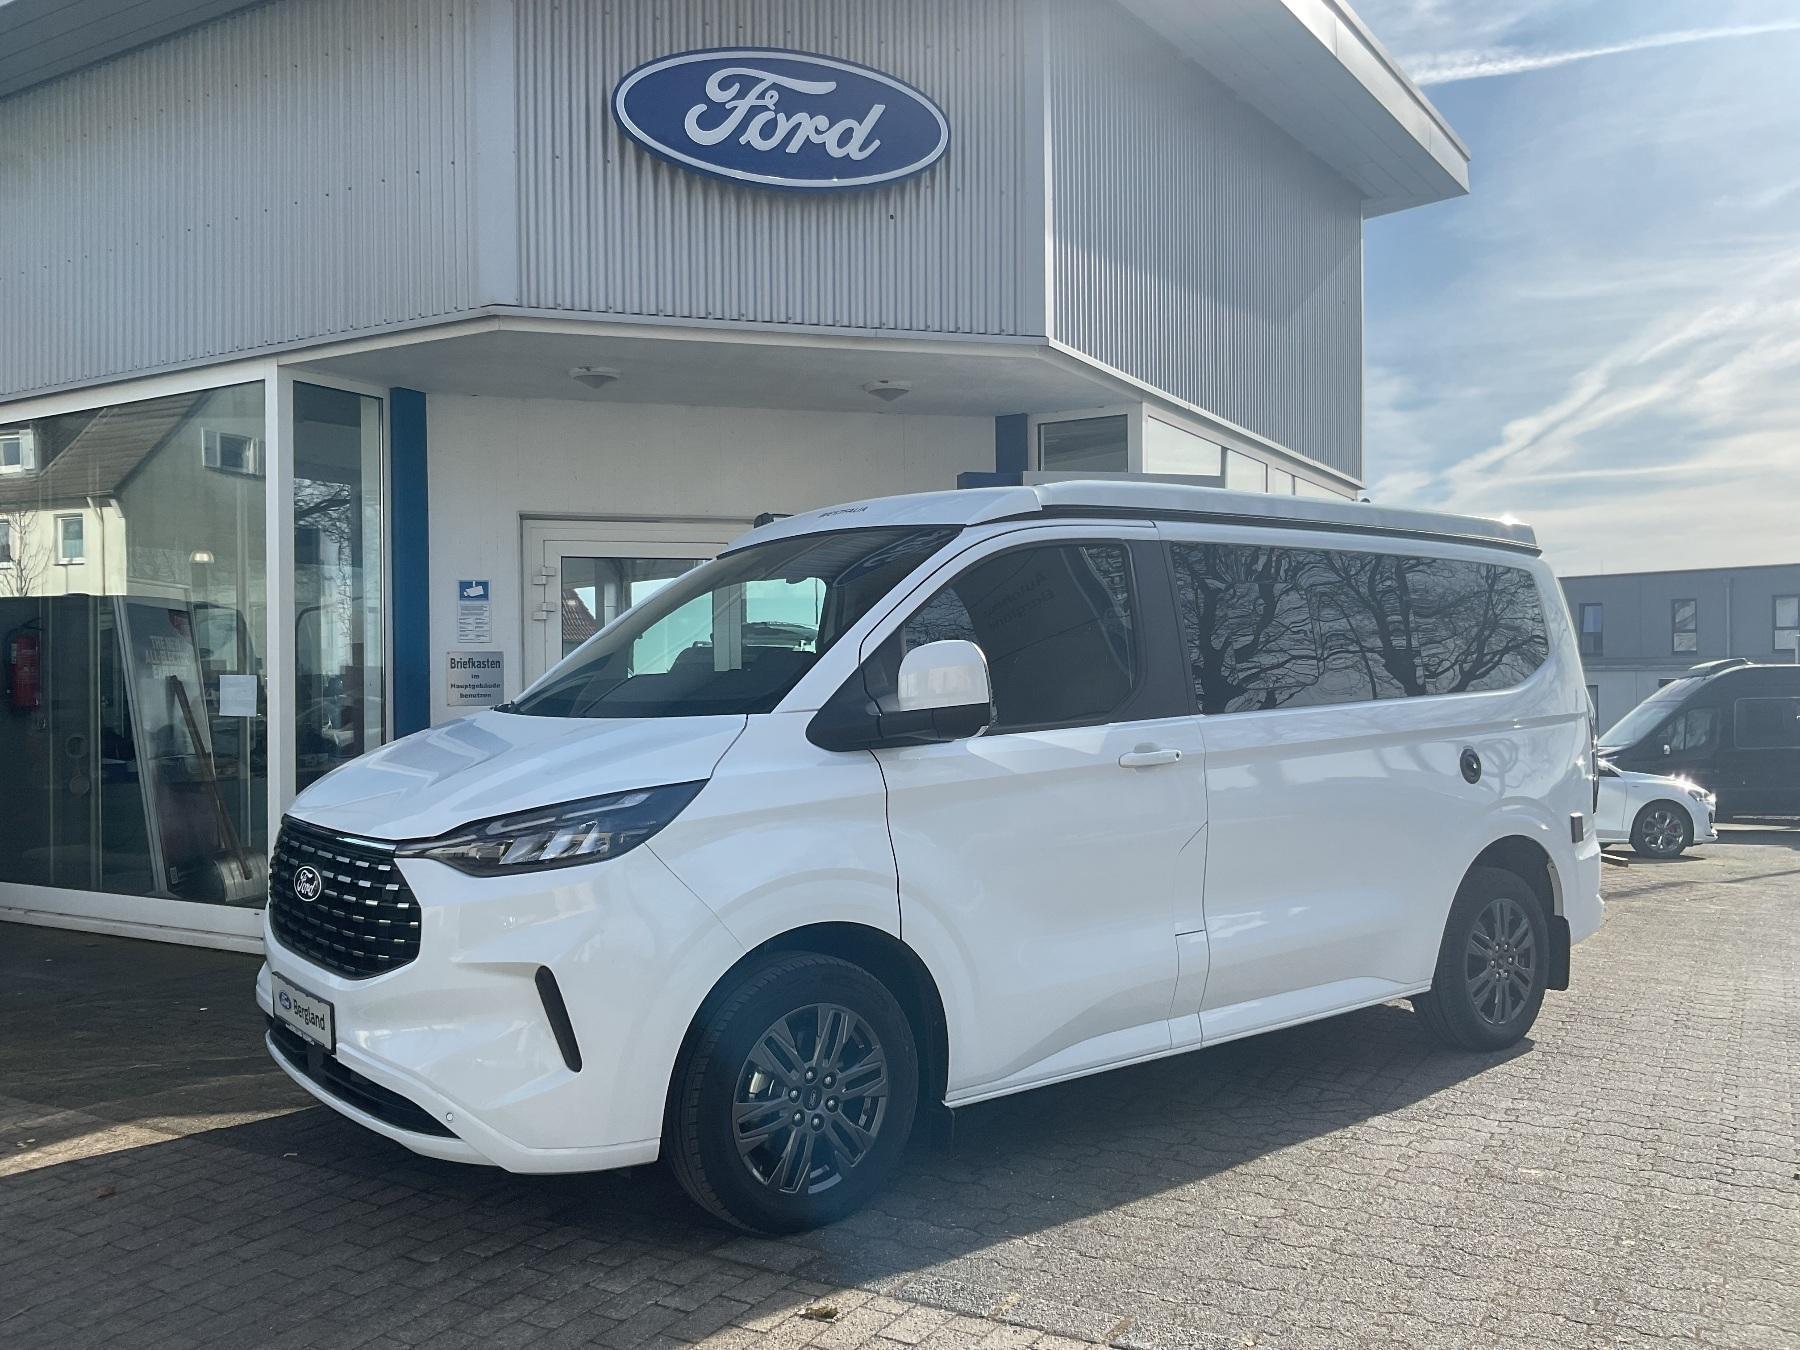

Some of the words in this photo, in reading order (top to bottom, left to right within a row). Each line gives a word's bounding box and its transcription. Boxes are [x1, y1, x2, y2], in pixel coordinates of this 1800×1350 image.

[684, 67, 885, 161] Ford
[450, 657, 501, 669] Briefkasten
[297, 870, 317, 896] Ford
[293, 998, 325, 1031] Bergland
